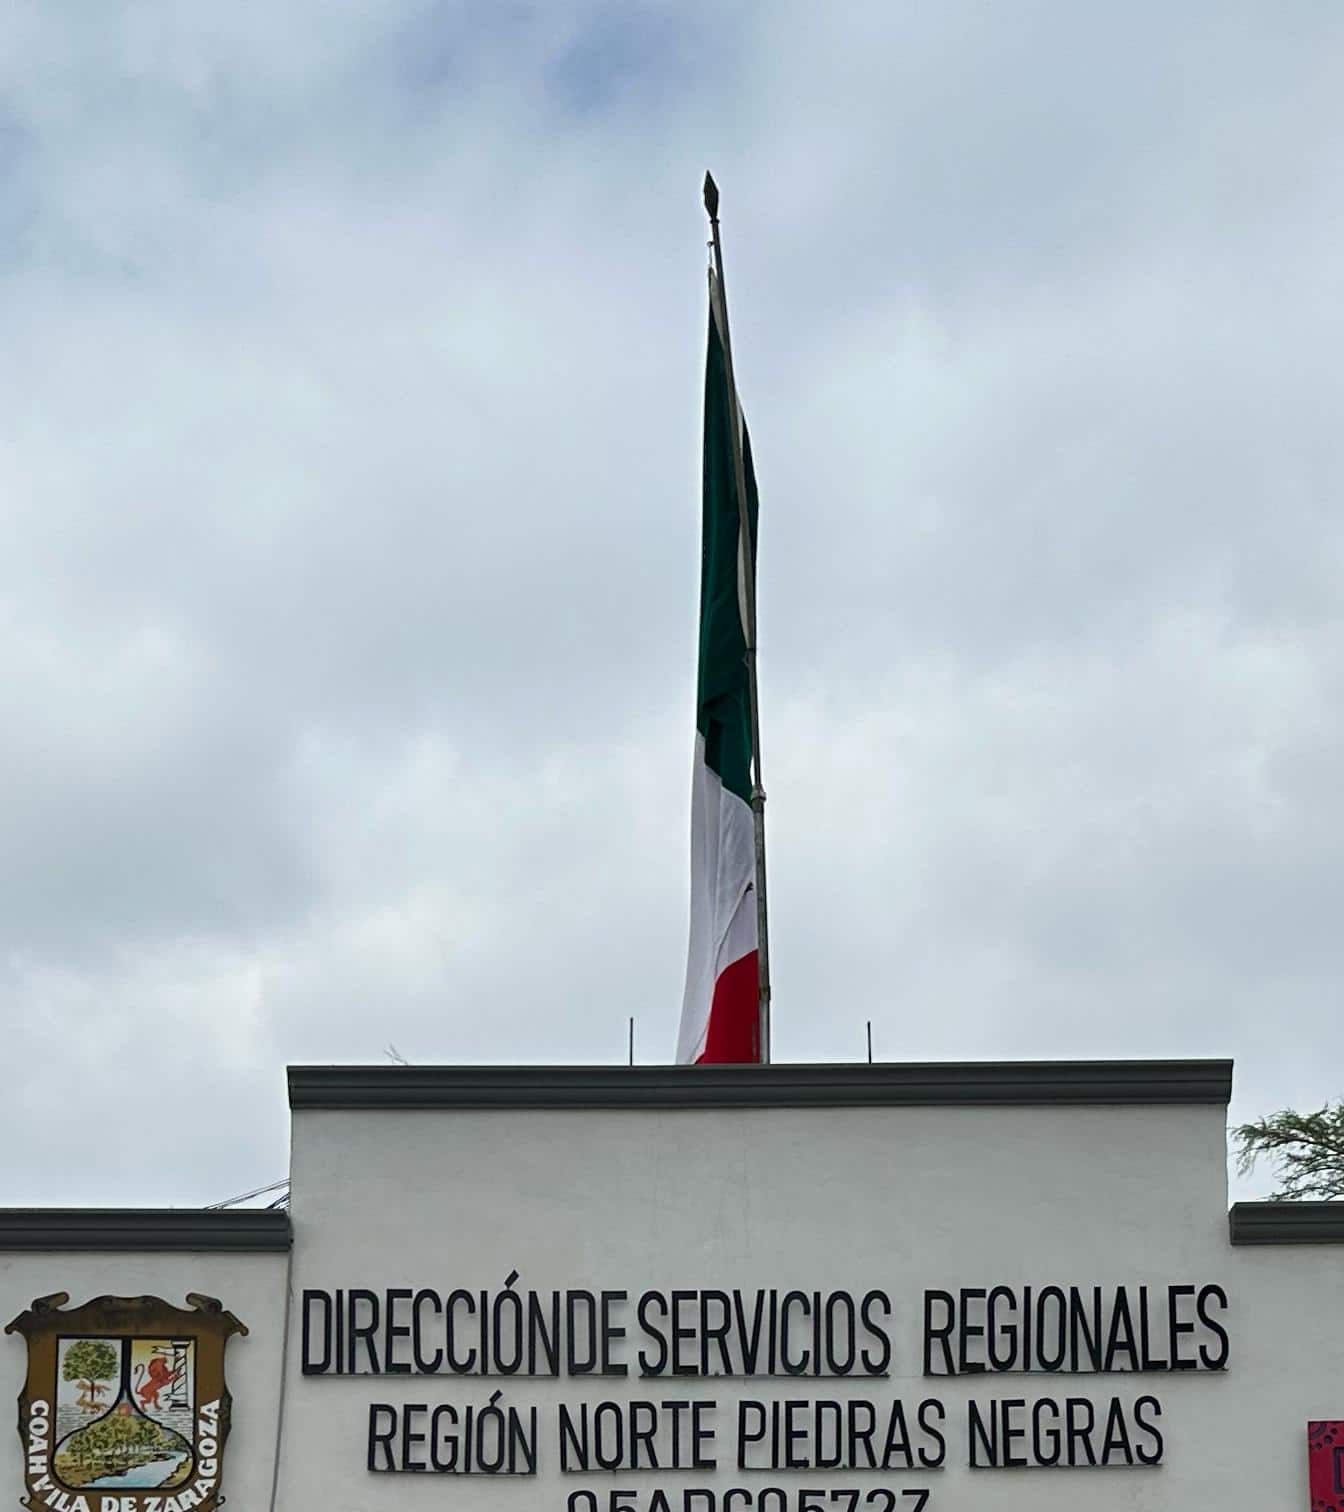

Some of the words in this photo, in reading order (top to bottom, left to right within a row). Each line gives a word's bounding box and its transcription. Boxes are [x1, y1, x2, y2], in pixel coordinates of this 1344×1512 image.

[301, 1270, 560, 1375] DIRECCIÓN
[567, 1289, 628, 1375] DE
[638, 1289, 892, 1375] SERVICIOS
[923, 1284, 1229, 1373] REGIONALES
[368, 1390, 536, 1472] REGIÓN
[559, 1400, 717, 1470] NORTE
[737, 1398, 945, 1468] PIEDRAS
[968, 1396, 1164, 1467] NEGRAS
